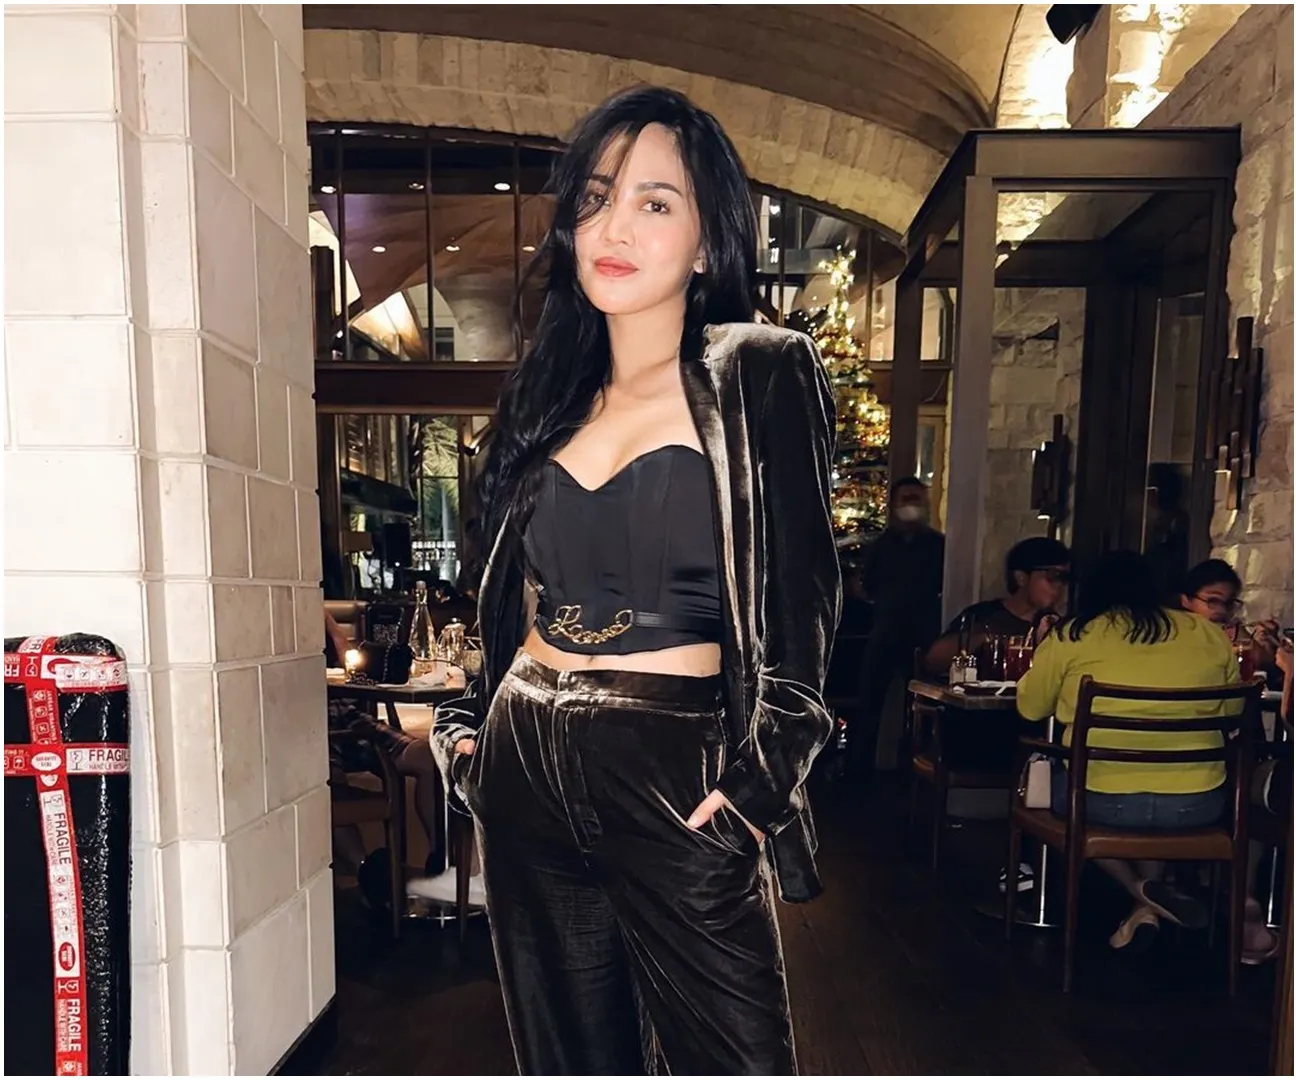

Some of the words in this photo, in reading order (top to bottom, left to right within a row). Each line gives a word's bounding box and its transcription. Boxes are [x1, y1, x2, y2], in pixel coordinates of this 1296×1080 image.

[89, 749, 129, 762] FRAGIL
[54, 812, 71, 865] FRAGILE
[68, 998, 81, 1052] FRAGILE
